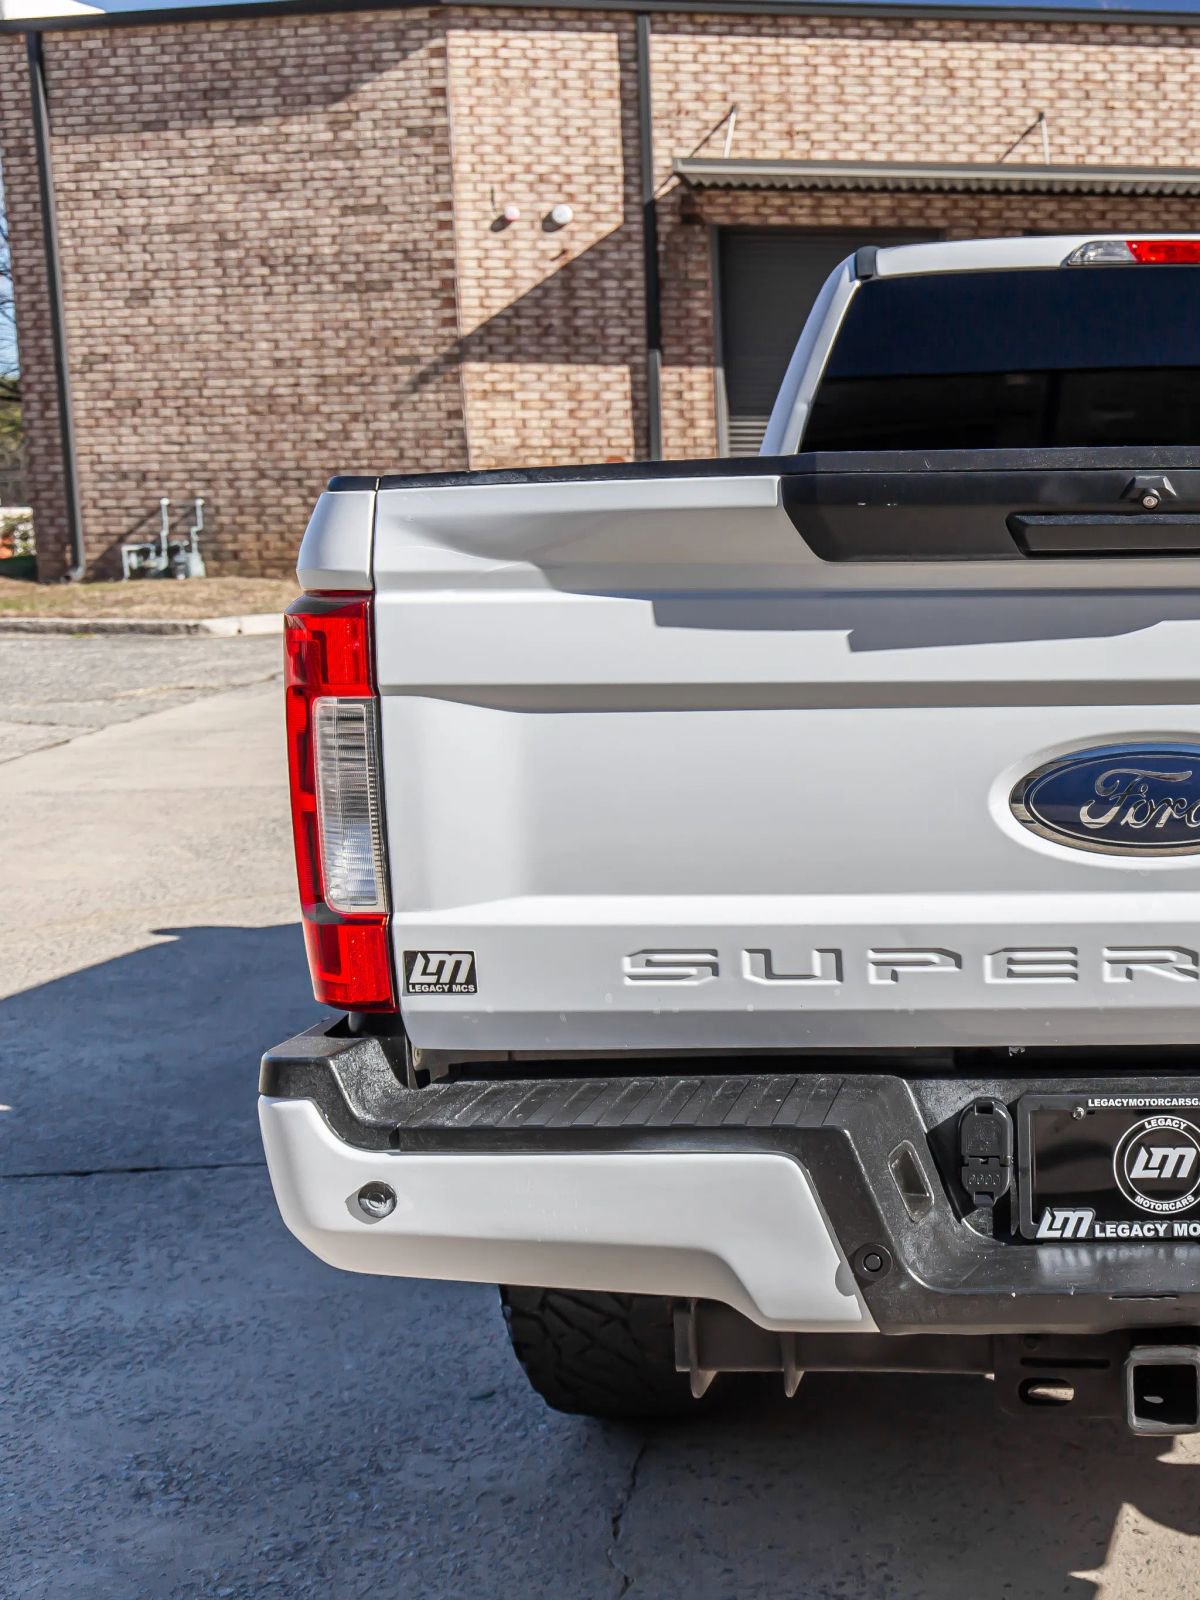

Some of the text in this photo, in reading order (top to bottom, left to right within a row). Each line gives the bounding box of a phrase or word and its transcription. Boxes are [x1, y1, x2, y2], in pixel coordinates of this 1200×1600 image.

[622, 946, 1200, 986] SUPER
[409, 984, 475, 993] LEGACY MCS
[1144, 1118, 1188, 1131] LEGACY
[1134, 1194, 1195, 1212] MOTORCARS
[1094, 1221, 1168, 1238] LEGACY
